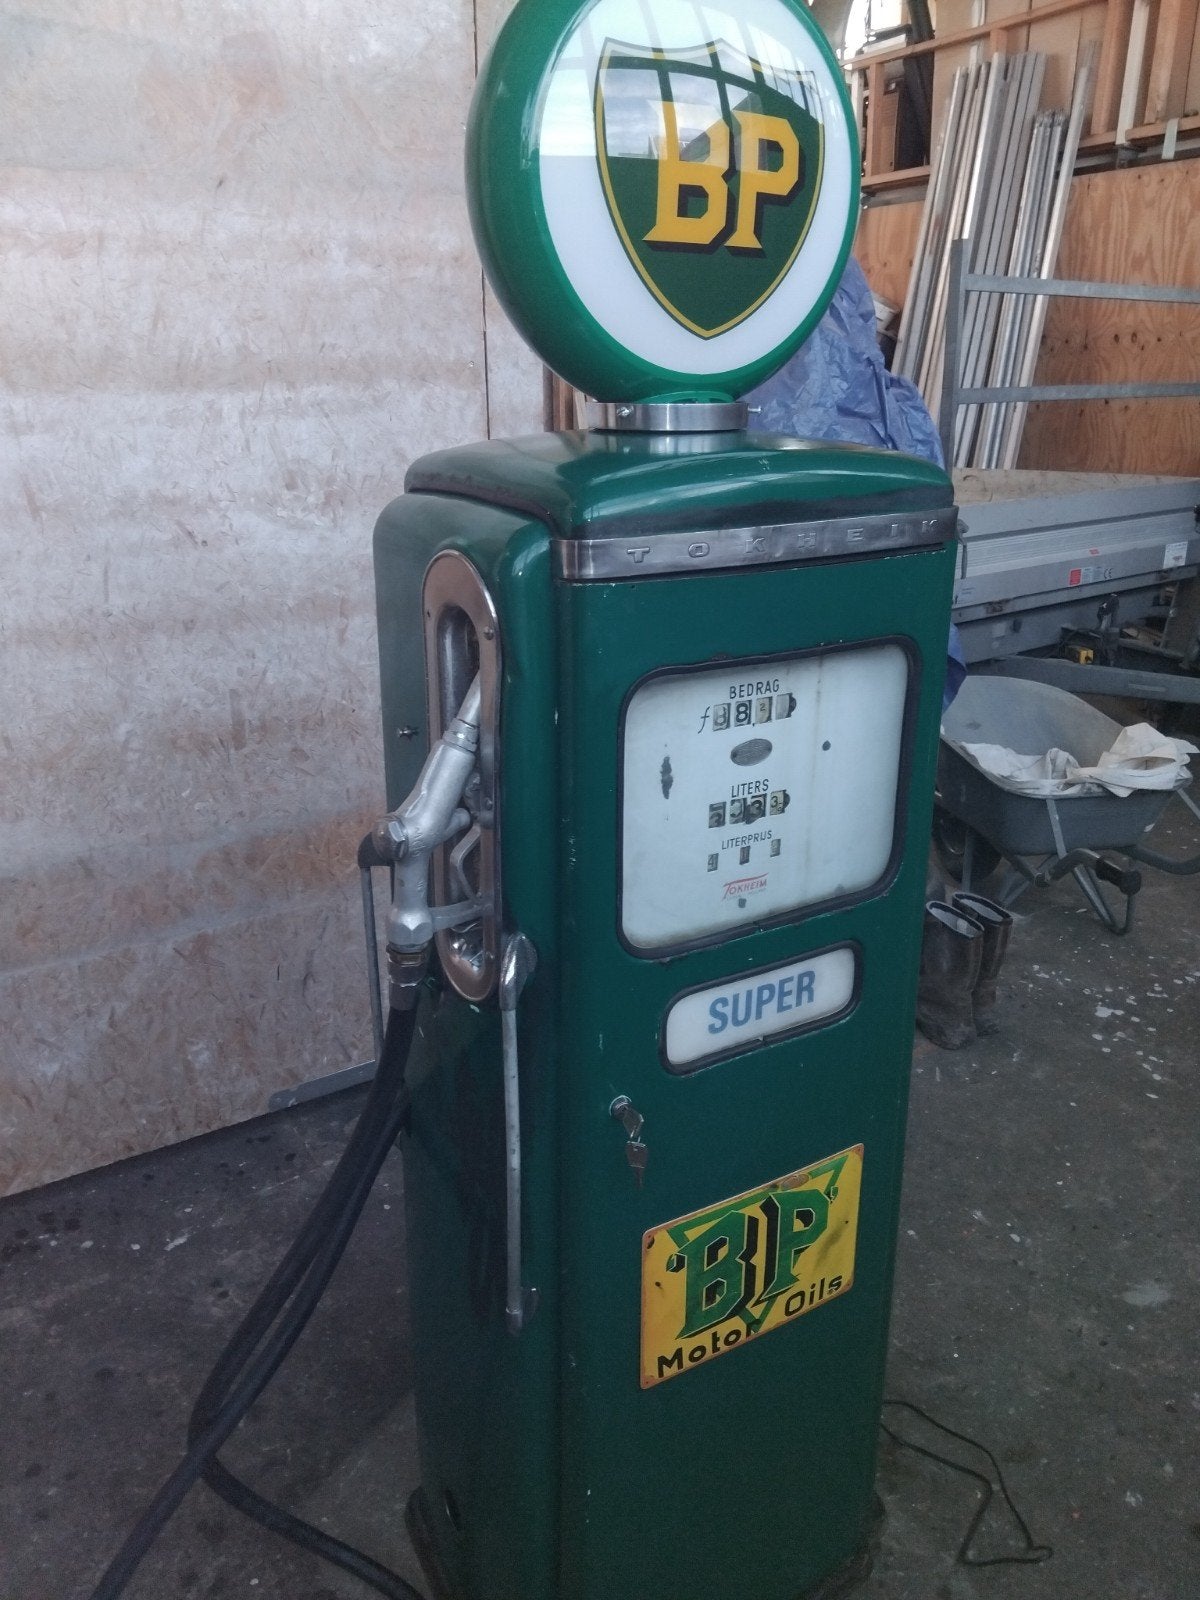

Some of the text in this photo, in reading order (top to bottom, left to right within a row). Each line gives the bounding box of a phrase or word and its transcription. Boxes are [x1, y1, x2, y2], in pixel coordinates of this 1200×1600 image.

[642, 99, 801, 250] BP
[729, 679, 780, 699] BEDRAG
[731, 779, 769, 798] LITERS
[708, 970, 816, 1034] SUPER
[667, 1187, 838, 1341] BP
[657, 1275, 843, 1378] Motor Oils
